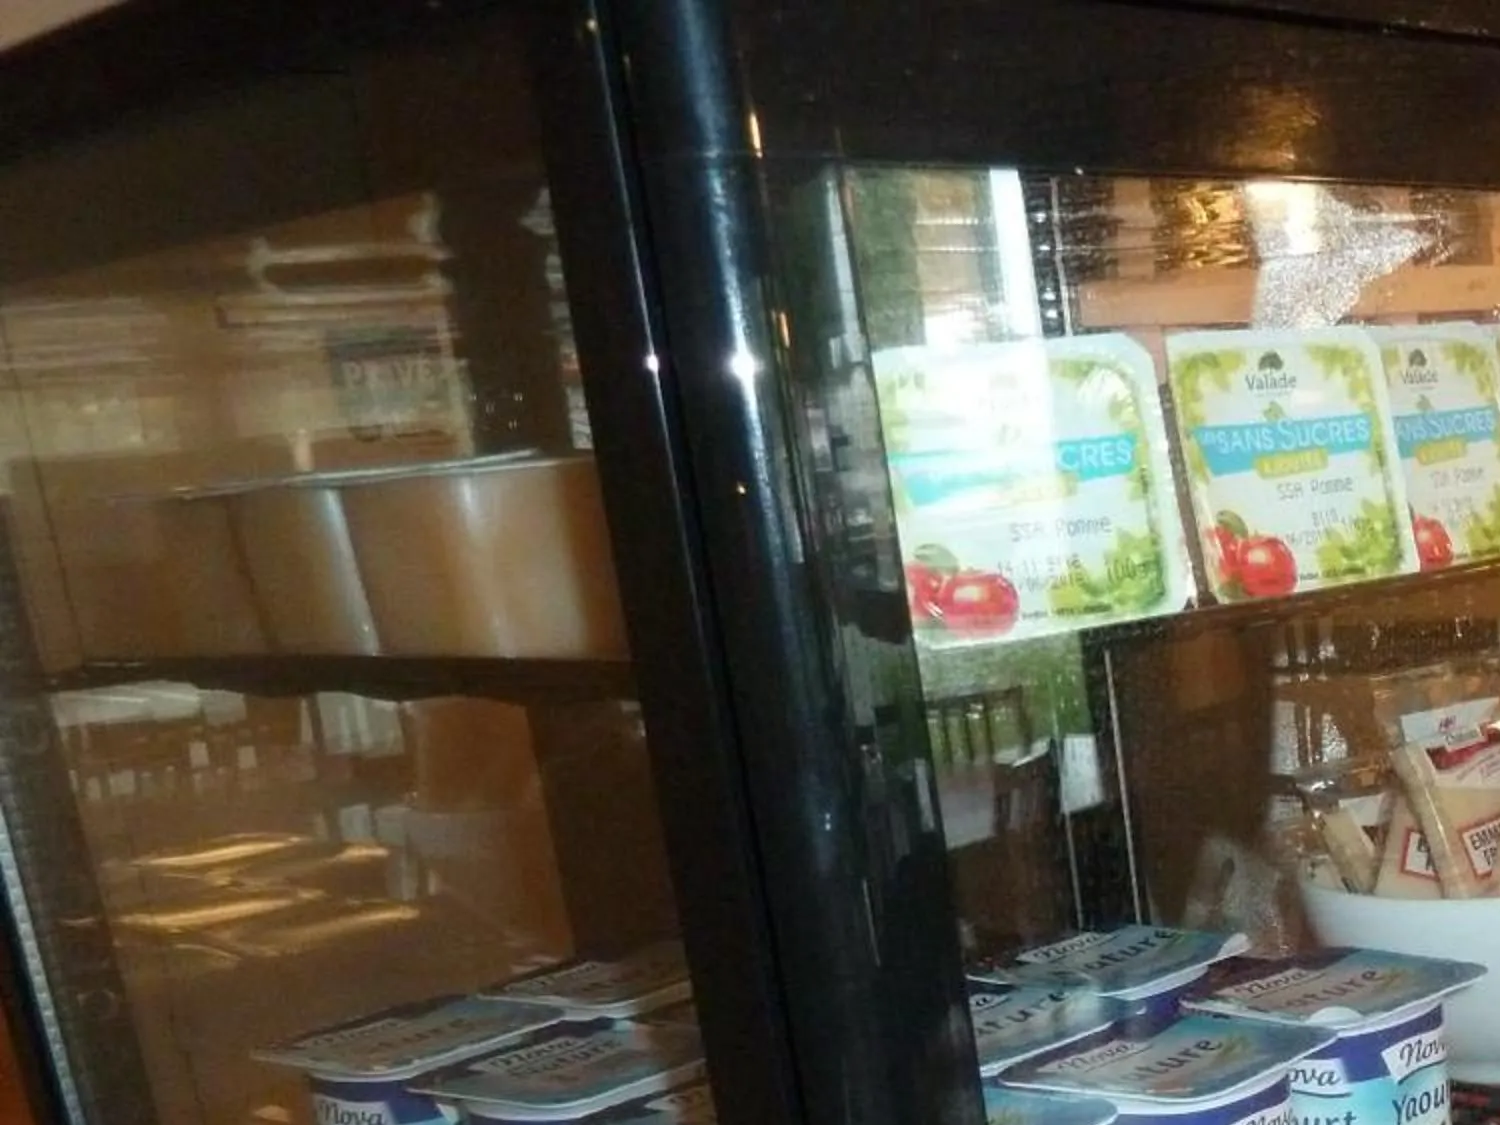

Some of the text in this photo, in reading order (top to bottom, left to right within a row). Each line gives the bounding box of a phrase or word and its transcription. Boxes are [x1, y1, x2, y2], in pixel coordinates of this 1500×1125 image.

[1245, 373, 1297, 390] Valade
[1218, 428, 1274, 454] SANS
[1276, 416, 1369, 450] SUCRES
[1428, 411, 1495, 438] SUCRES
[1058, 439, 1132, 471] CRES
[1286, 1067, 1342, 1087] ova
